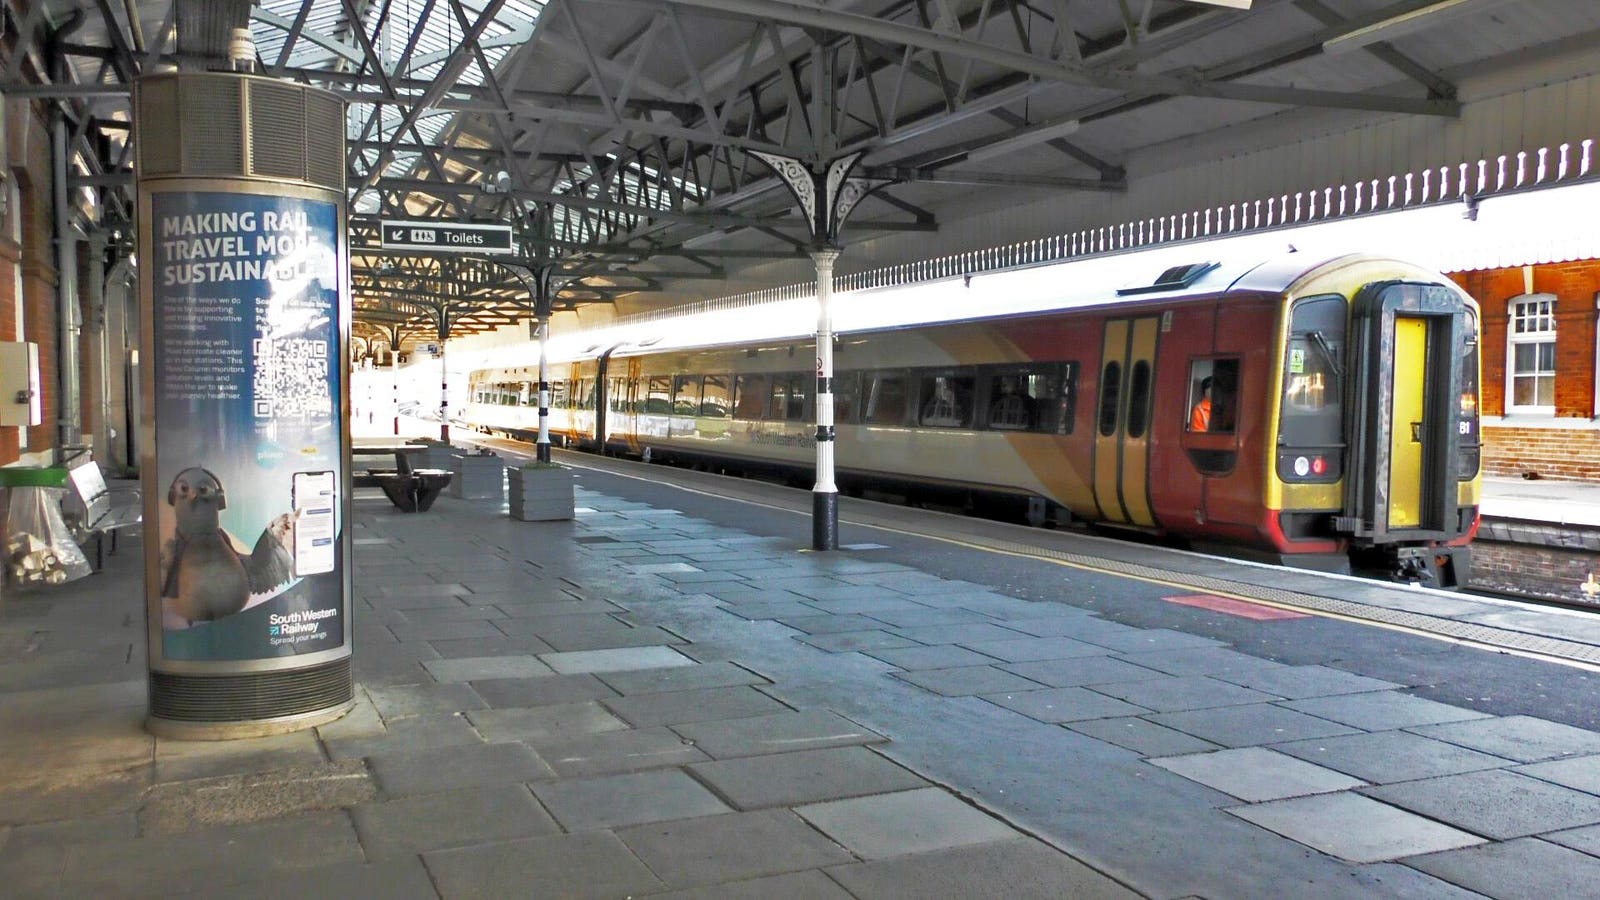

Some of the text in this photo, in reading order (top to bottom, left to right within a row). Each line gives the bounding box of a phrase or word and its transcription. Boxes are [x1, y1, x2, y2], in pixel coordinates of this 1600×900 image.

[164, 211, 312, 237] MAKING RAIL
[444, 232, 484, 244] Toilets
[164, 236, 250, 261] TRAVEL
[270, 608, 337, 625] South Western
[281, 622, 319, 634] Railway
